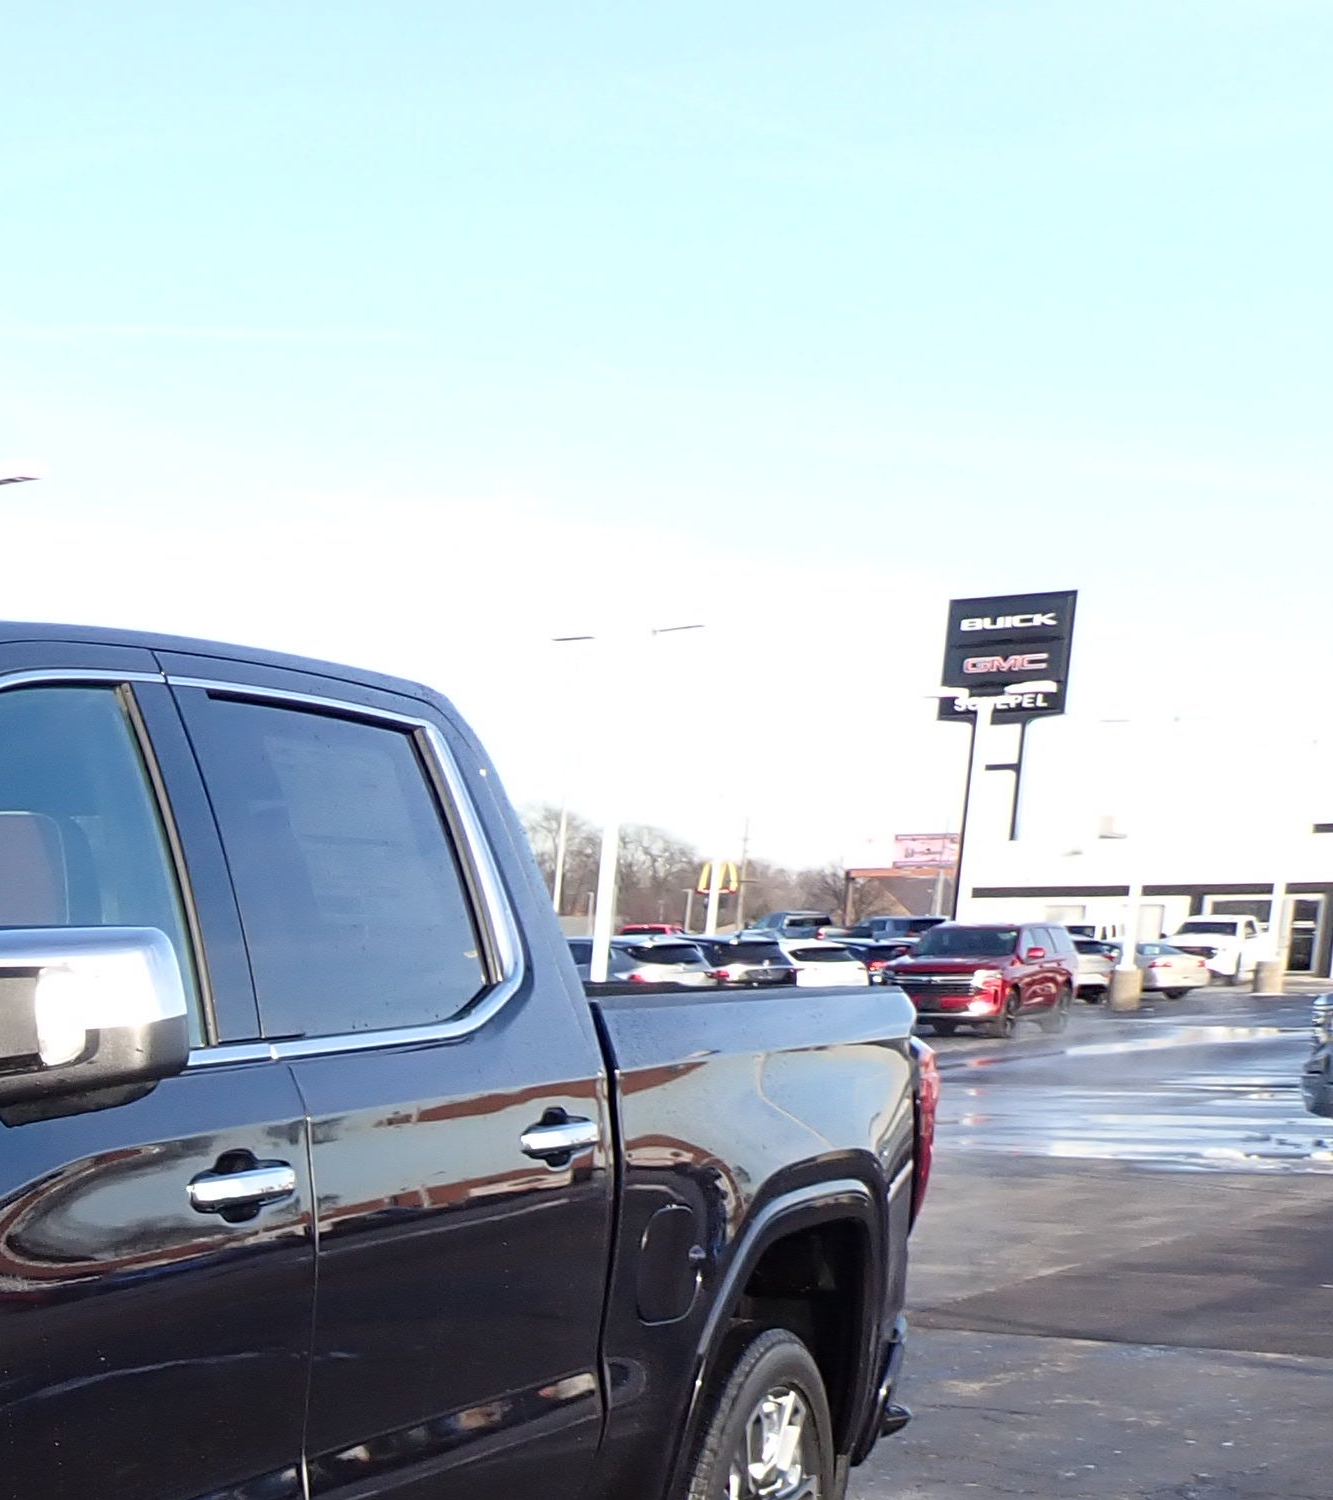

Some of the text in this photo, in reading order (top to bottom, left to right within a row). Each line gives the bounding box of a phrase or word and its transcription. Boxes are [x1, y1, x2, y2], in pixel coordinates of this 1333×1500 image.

[960, 613, 1057, 631] BUICK
[963, 653, 1049, 673] GMC
[954, 693, 1048, 712] SCEPEL
